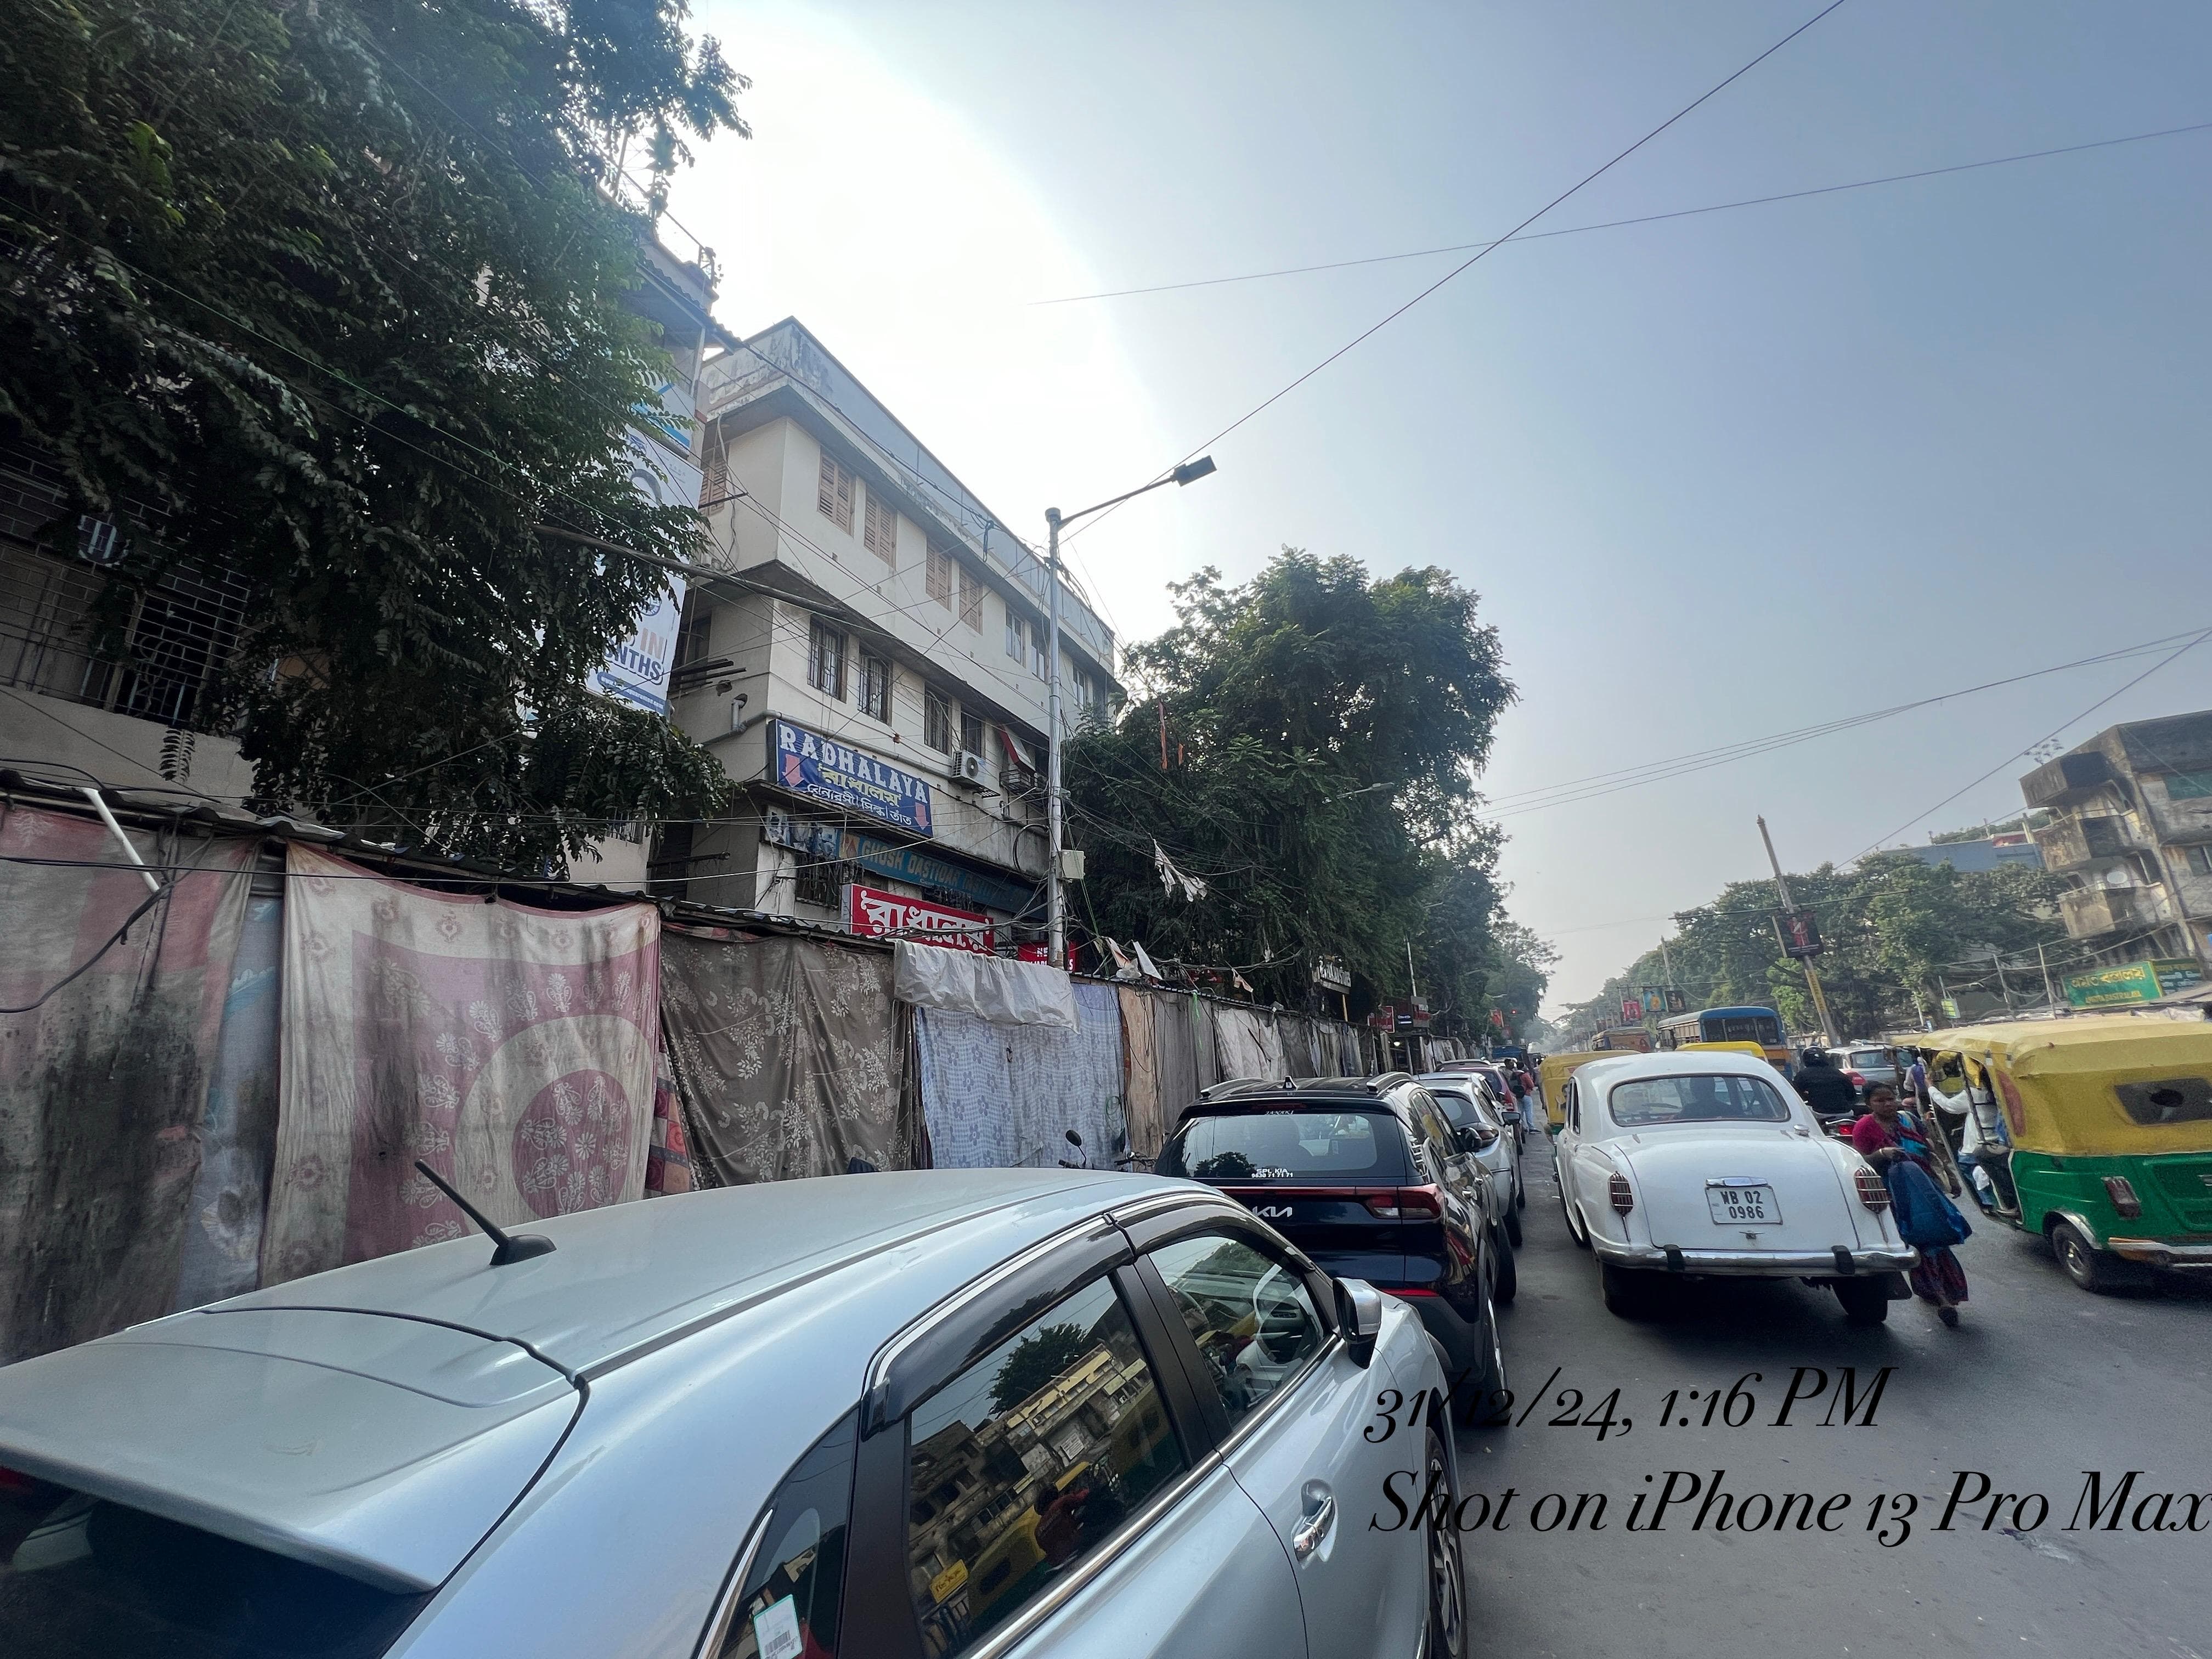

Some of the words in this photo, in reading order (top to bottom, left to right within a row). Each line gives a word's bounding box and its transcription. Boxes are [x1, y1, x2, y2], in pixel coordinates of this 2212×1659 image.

[640, 627, 664, 660] IN
[605, 645, 661, 681] NTHS
[778, 724, 928, 804] RADHALAYA
[889, 810, 912, 825] তাঁত
[861, 840, 905, 871] GHOSH
[907, 854, 960, 888] DASTIDAR
[1720, 1190, 1739, 1205] WB
[1744, 1190, 1763, 1204] 02
[1252, 1206, 1293, 1217] KIA
[1729, 1205, 1764, 1219] 0986
